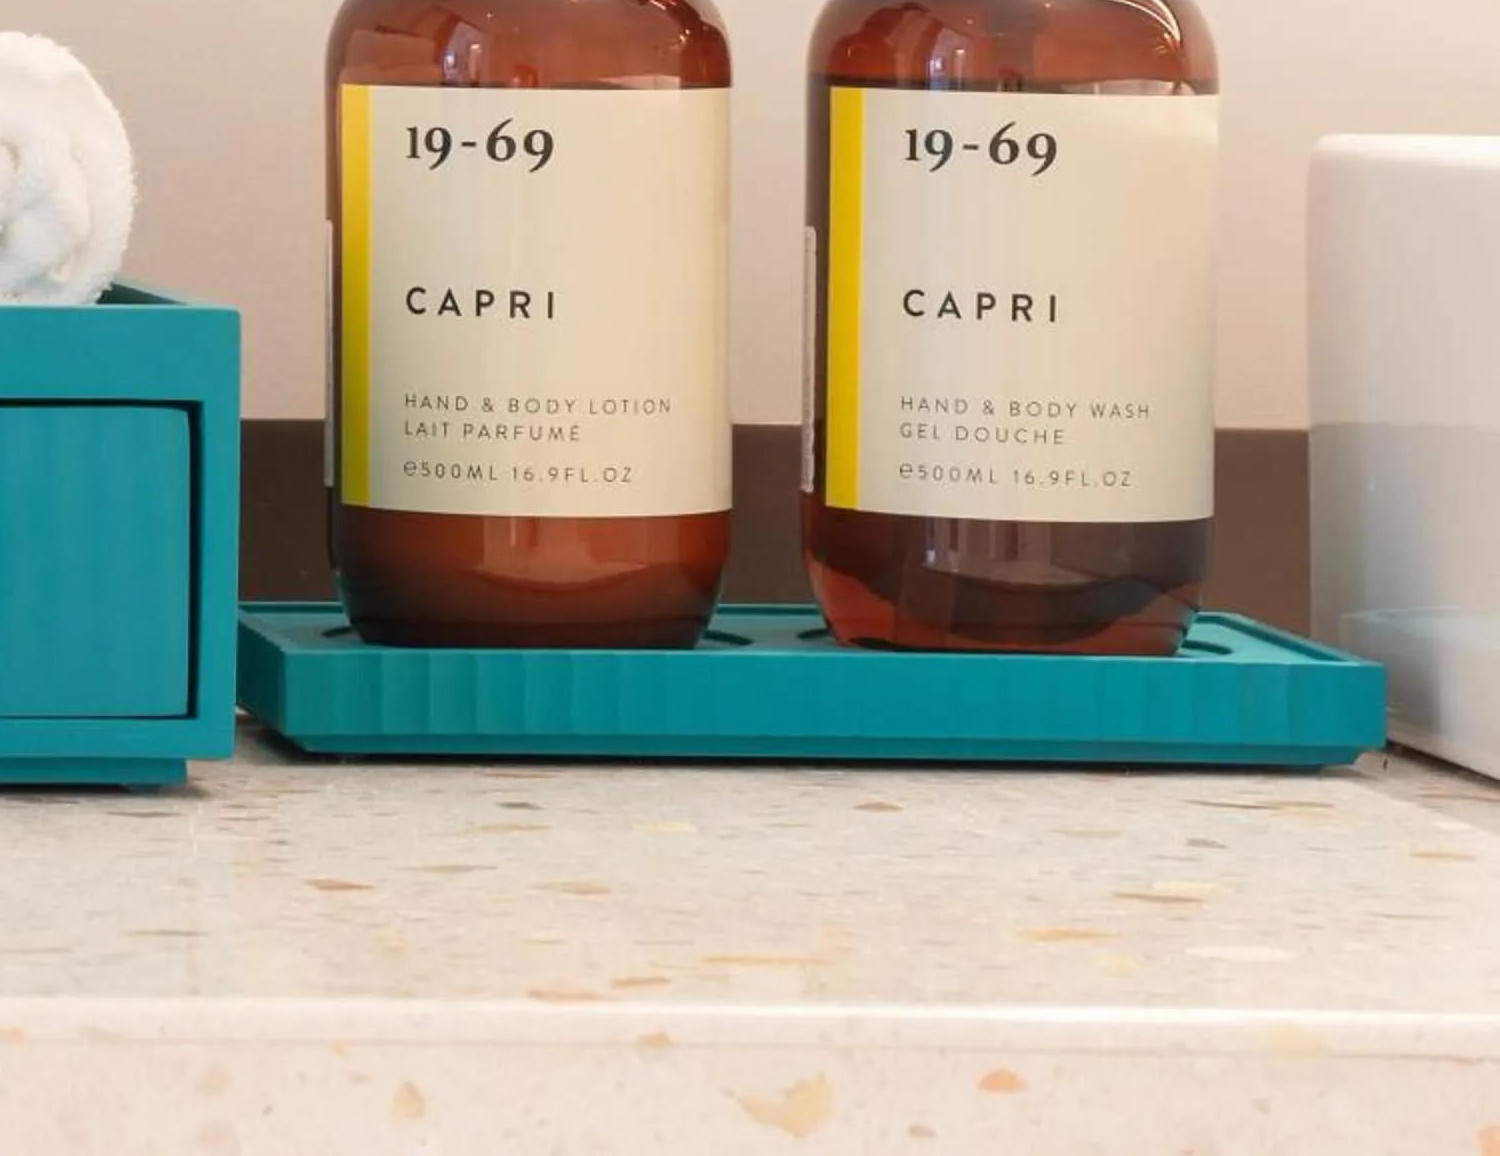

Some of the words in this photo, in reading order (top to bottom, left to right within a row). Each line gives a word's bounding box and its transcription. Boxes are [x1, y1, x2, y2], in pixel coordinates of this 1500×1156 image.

[405, 117, 555, 173] 19-69
[904, 121, 1058, 176] 19-69
[405, 286, 556, 320] CAPRI
[902, 289, 1057, 323] CAPRI
[404, 393, 469, 412] HAND
[481, 397, 495, 413] &
[508, 397, 577, 415] BODY
[589, 398, 672, 415] LOTION
[900, 396, 969, 415] HAND
[982, 400, 995, 416] &
[1009, 400, 1077, 418] BODY
[1090, 402, 1150, 420] WASH
[404, 421, 450, 439] LAIT
[463, 422, 581, 442] PARFUMÉ
[900, 422, 941, 441] GEL
[955, 425, 1066, 445] DOUCHE
